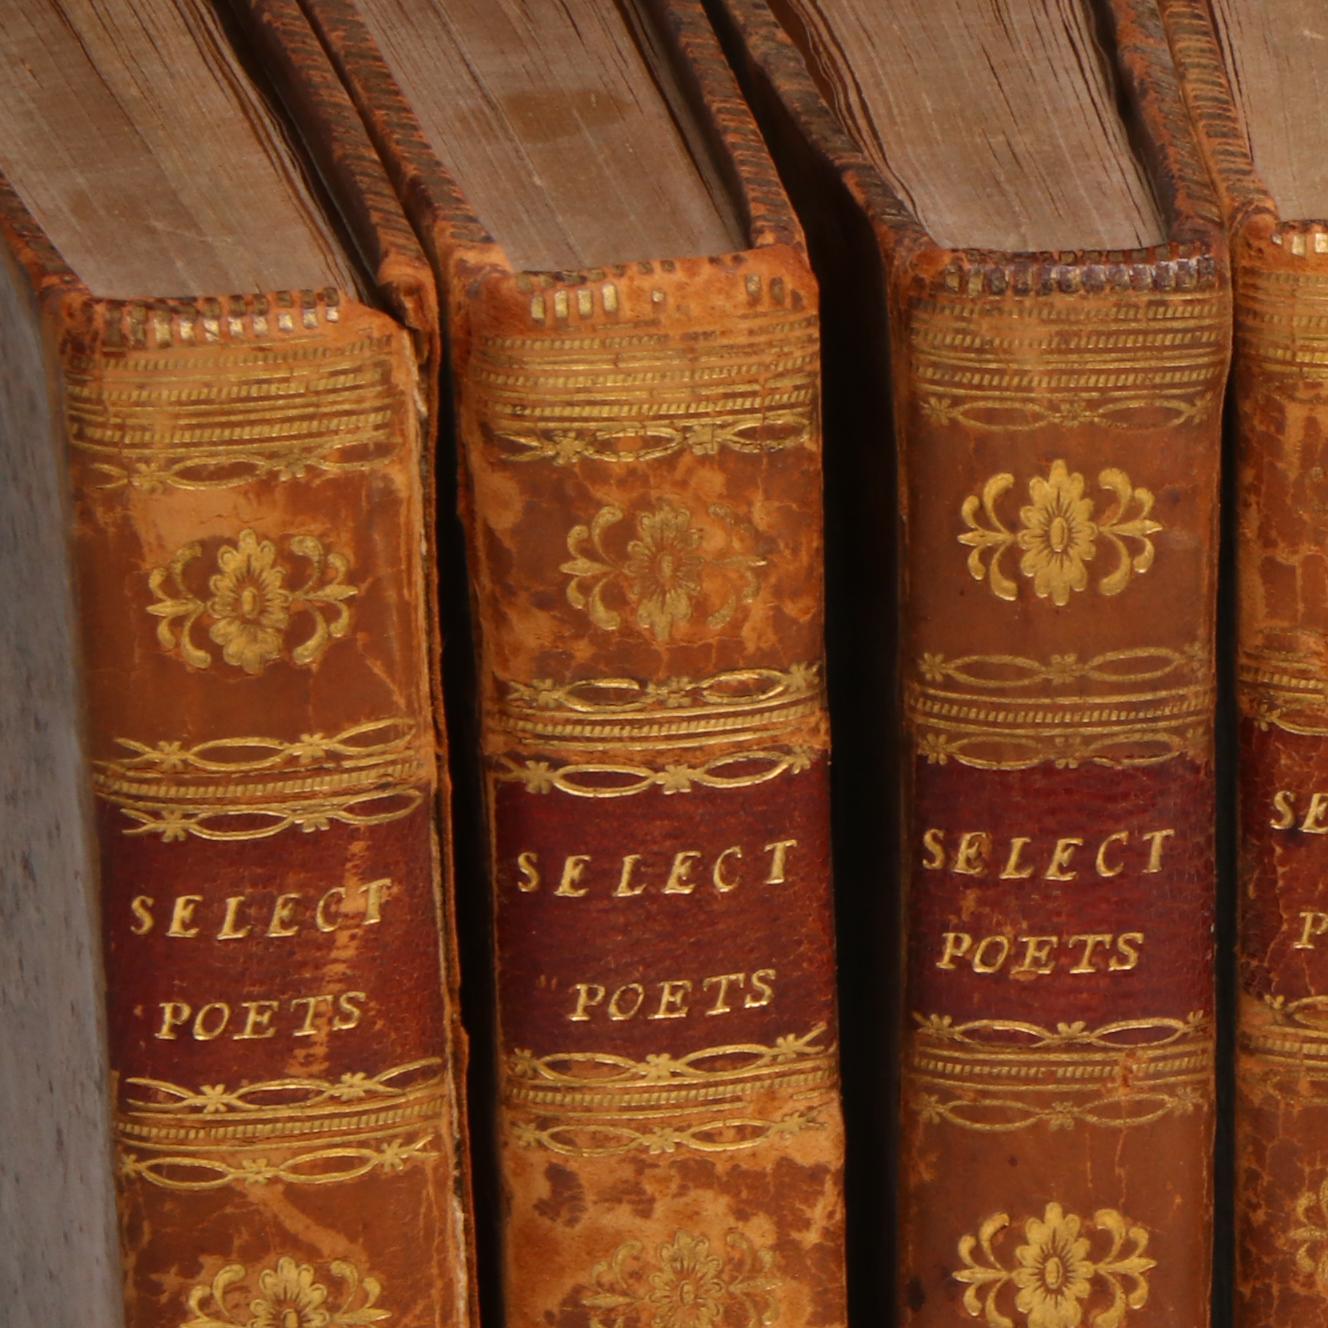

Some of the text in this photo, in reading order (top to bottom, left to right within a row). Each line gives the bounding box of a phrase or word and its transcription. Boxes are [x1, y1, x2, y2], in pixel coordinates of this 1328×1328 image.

[516, 839, 797, 898] SELECT
[921, 828, 1175, 881] SELECT
[130, 878, 393, 940] SELECT
[936, 932, 1144, 974] POETS
[154, 991, 367, 1041] POETS
[569, 969, 776, 1021] POETS
